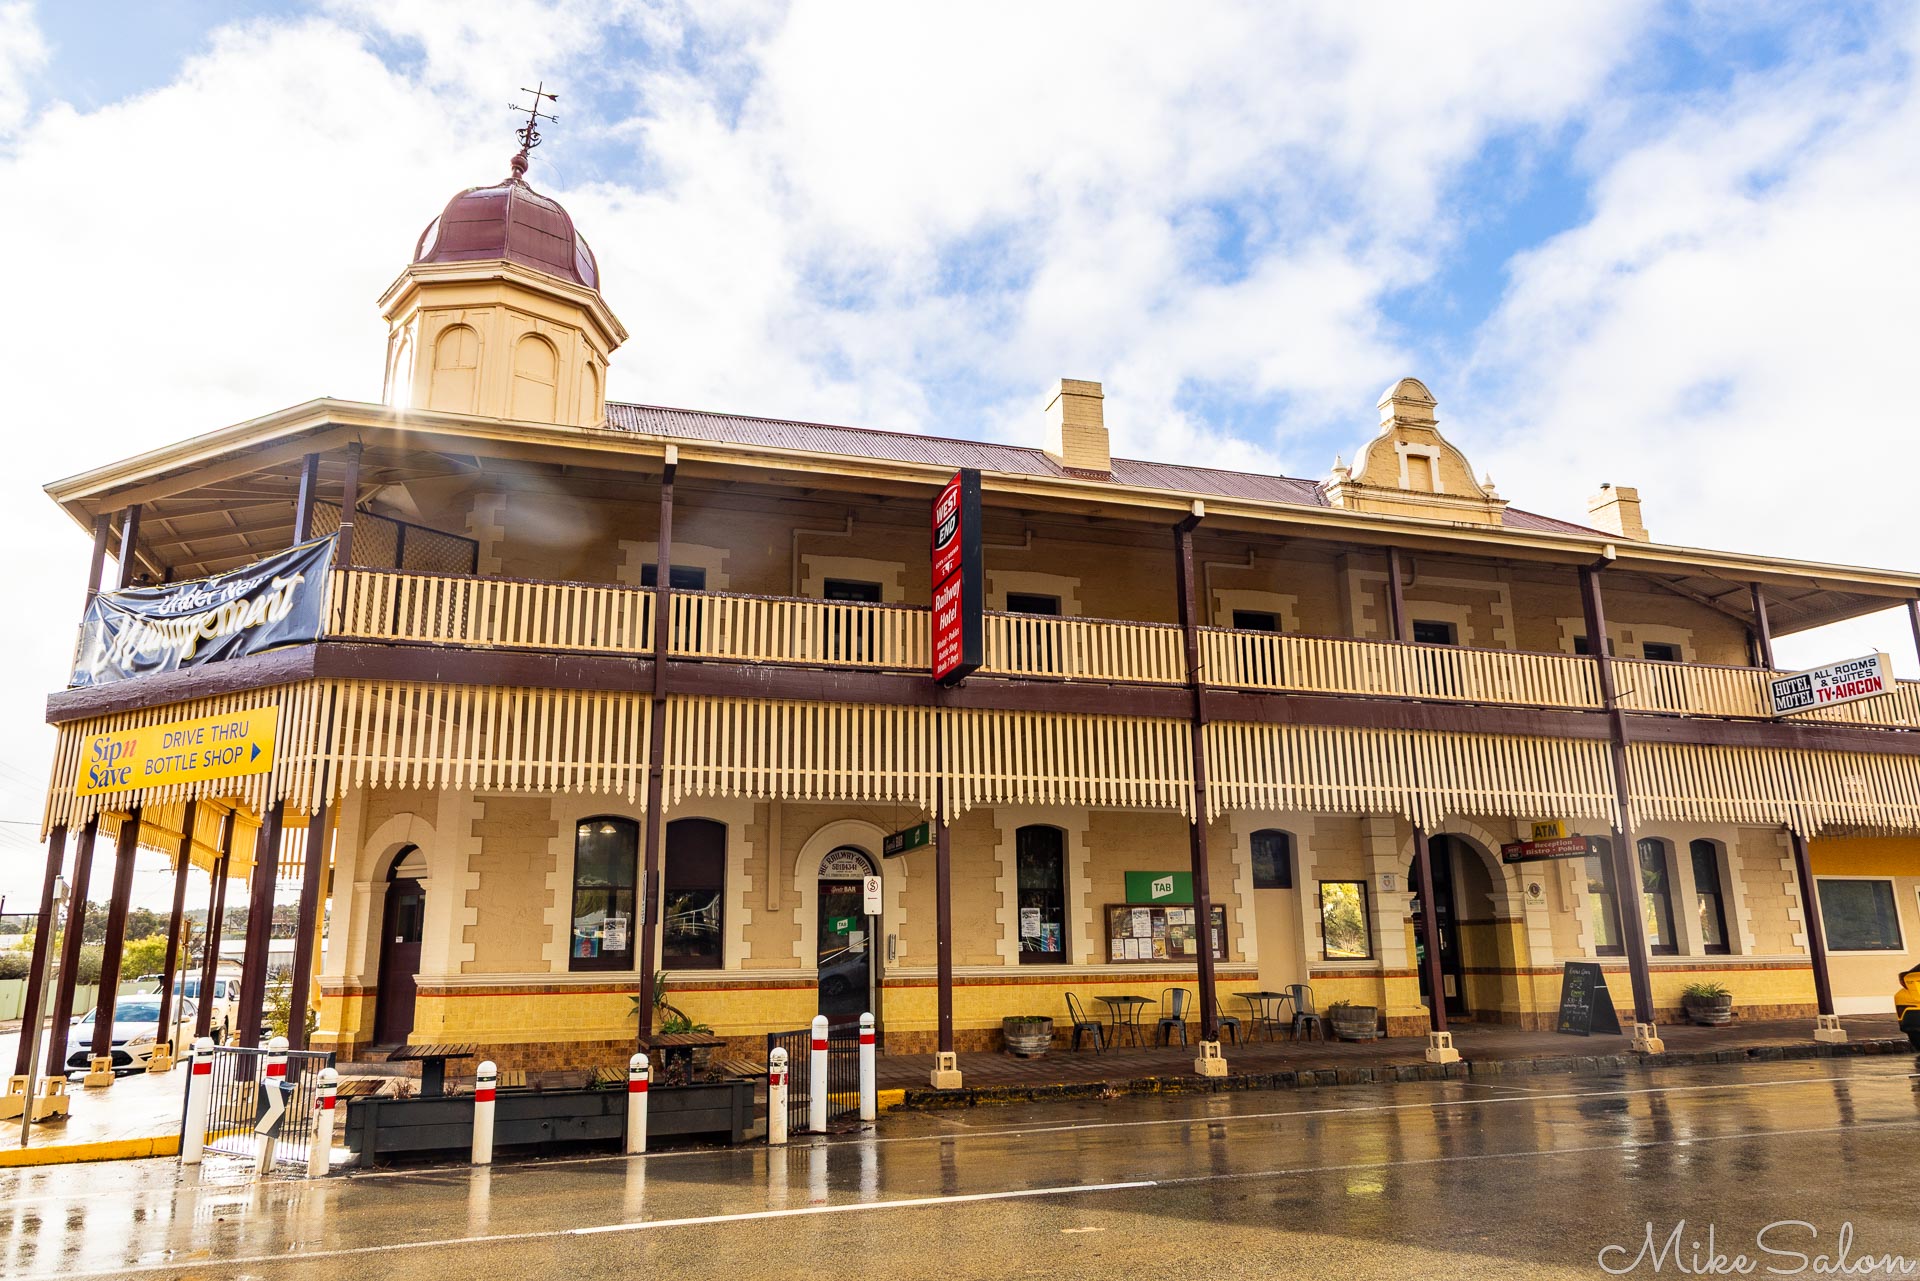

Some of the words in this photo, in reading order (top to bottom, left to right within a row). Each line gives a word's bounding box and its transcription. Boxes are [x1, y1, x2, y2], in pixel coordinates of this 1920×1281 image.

[937, 489, 958, 524] WEST
[938, 515, 956, 545] END
[158, 587, 220, 615] Under
[219, 575, 269, 602] New
[936, 578, 960, 612] Railway
[94, 571, 304, 672] Management
[940, 600, 957, 631] Hotel
[1814, 669, 1832, 680] ALL
[1834, 658, 1877, 675] ROOMS
[1821, 679, 1829, 687] &
[1831, 668, 1874, 685] SUITES
[1774, 676, 1811, 697] HOTEL
[1775, 690, 1814, 711] MOTEL
[163, 728, 205, 749] DRIVE
[211, 720, 250, 742] THRU
[144, 752, 198, 775] BOTTLE
[203, 746, 244, 767] SHOP
[87, 764, 132, 790] Save
[1535, 824, 1558, 838] ATM
[1534, 840, 1573, 849] Reception
[818, 862, 829, 876] THE
[826, 852, 857, 865] RAILWAY
[855, 857, 871, 876] HOTEL
[1154, 883, 1171, 892] TAB
